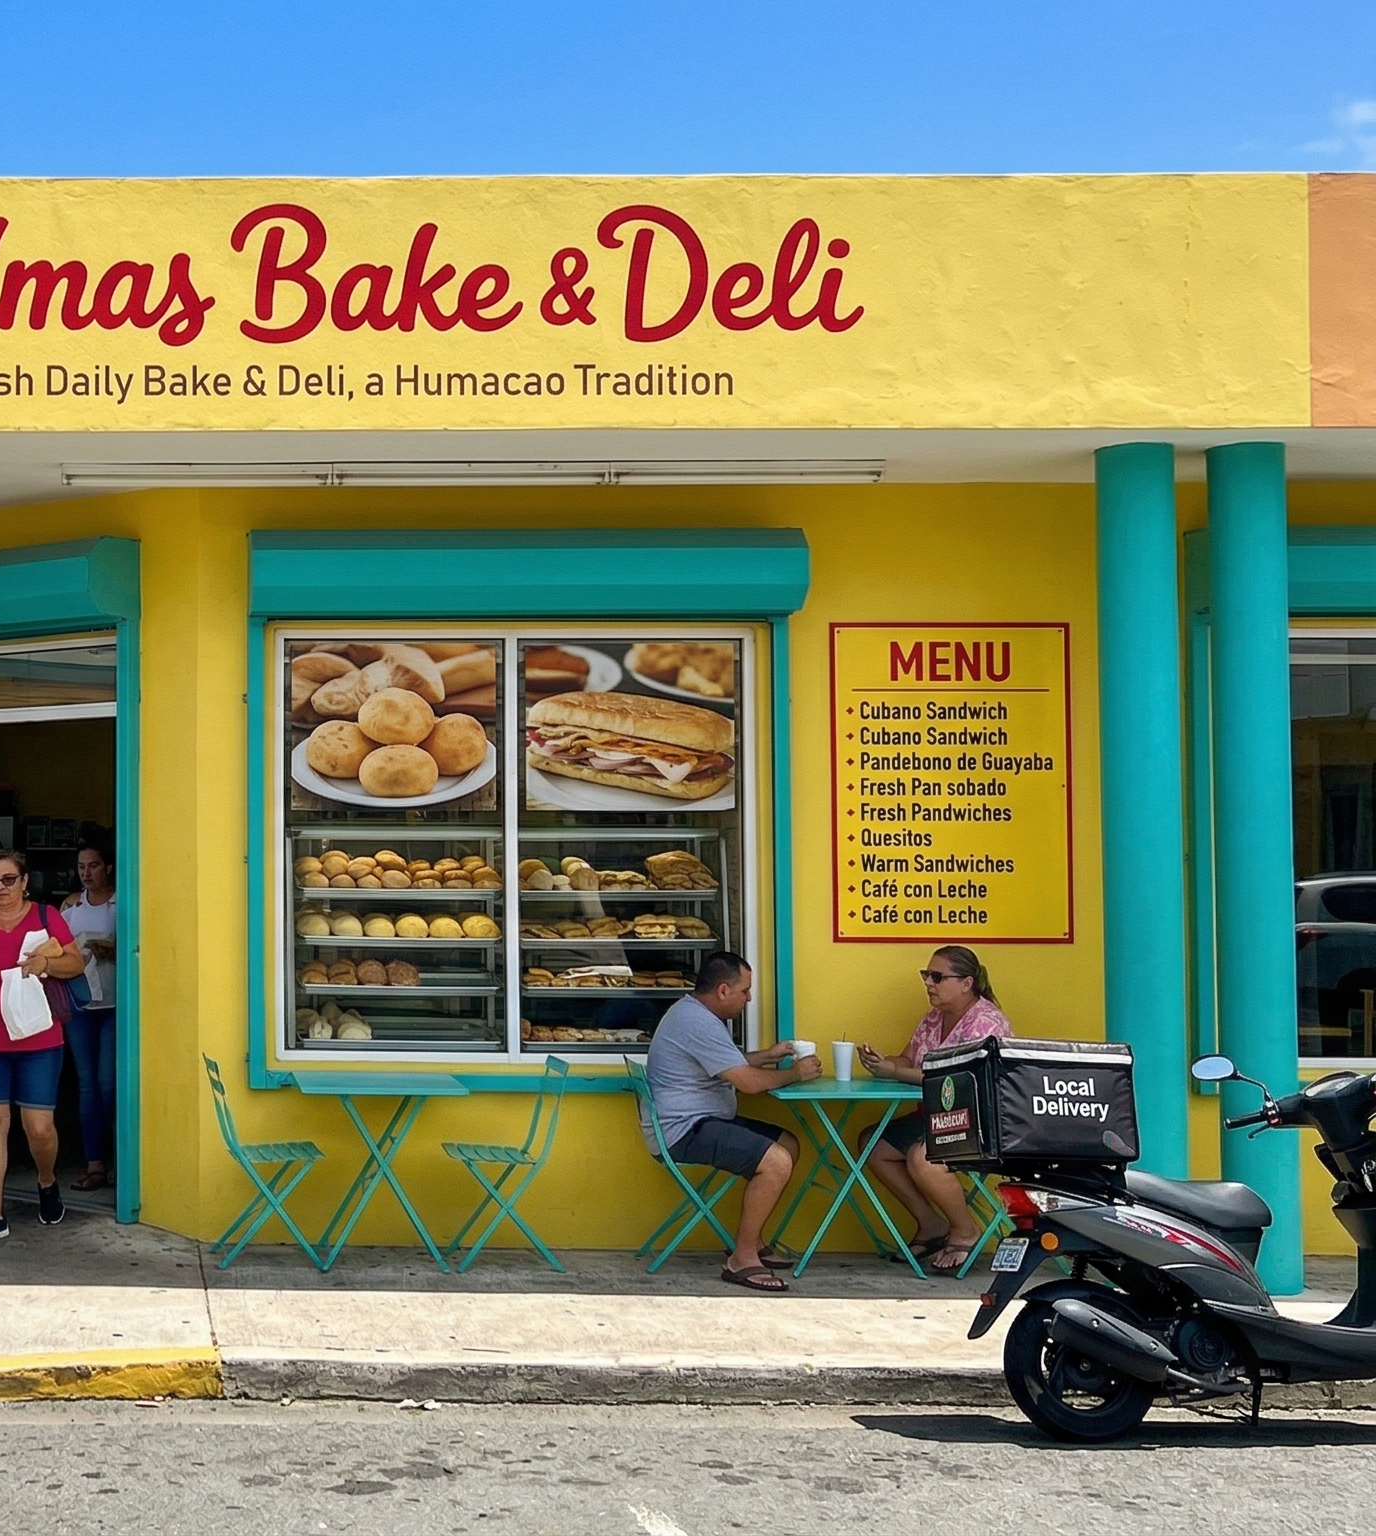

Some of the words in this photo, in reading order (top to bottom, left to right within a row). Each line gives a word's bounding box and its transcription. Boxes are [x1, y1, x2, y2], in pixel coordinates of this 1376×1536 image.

[230, 203, 524, 344] Bake
[539, 247, 597, 326] &
[596, 204, 865, 343] Deli
[46, 364, 134, 405] Daily
[144, 364, 232, 396] Bake
[243, 364, 267, 396] &
[278, 364, 354, 401] Deli,
[365, 373, 384, 396] a
[396, 364, 565, 396] Humacao
[573, 364, 733, 396] Tradition
[890, 641, 1011, 683] MENU
[860, 701, 922, 720] Cubano
[926, 701, 1008, 720] Sandwich
[860, 726, 922, 745] Cubano
[926, 726, 1008, 745] Sandwich
[860, 751, 952, 771] Pandebono
[957, 752, 977, 771] de
[982, 751, 1054, 776] Guayaba
[860, 777, 906, 796] Fresh
[911, 777, 942, 796] Pan
[947, 777, 1007, 796] sobado
[860, 802, 906, 822] Fresh
[911, 802, 1012, 822] Pandwiches
[861, 828, 933, 847] Quesitos
[861, 853, 909, 873] Warm
[913, 853, 1015, 873] Sandwiches
[861, 879, 898, 898] Café
[903, 884, 933, 898] con
[938, 879, 987, 899] Leche
[861, 904, 899, 924] Café
[903, 909, 933, 924] con
[938, 905, 988, 924] Leche
[1042, 1075, 1096, 1098] Local
[1032, 1096, 1110, 1123] Delivery
